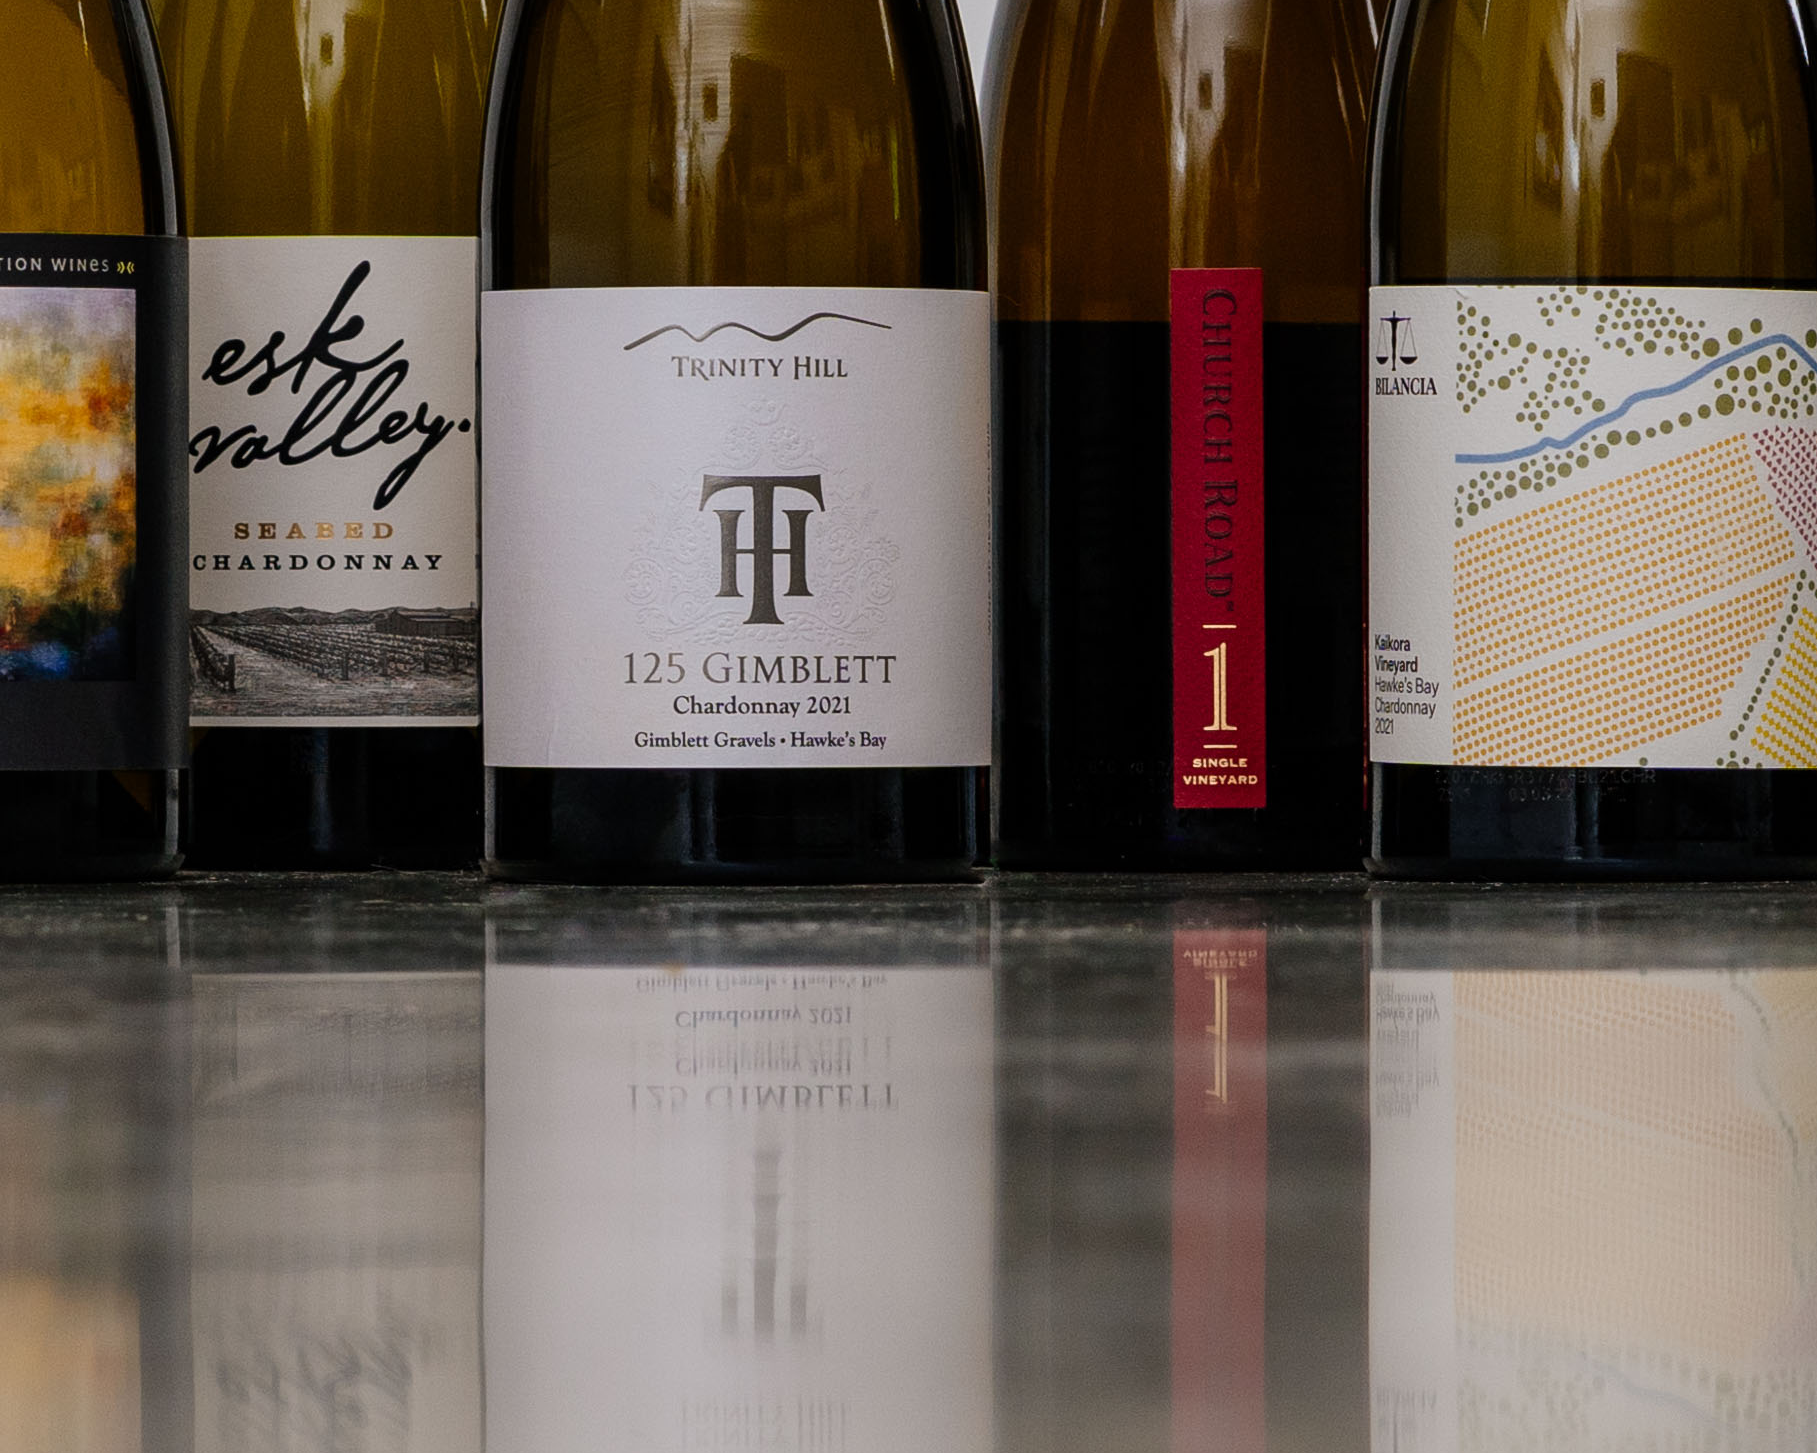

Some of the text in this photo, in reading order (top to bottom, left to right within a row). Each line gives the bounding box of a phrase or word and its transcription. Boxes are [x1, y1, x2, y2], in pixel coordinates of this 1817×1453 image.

[201, 260, 405, 396] esk
[671, 355, 848, 381] TRINITY HILL
[1202, 288, 1237, 464] CHURCH
[1375, 377, 1438, 396] BILANCIA
[233, 522, 394, 540] SEABED
[192, 554, 443, 571] CHARDONNAY
[1374, 635, 1410, 652] Kaikora
[624, 651, 897, 684] 125 GIMBLETT
[1374, 656, 1419, 675] Vineyard
[1202, 642, 1238, 731] 1
[1374, 677, 1439, 698] Hawke's Bay
[673, 695, 852, 718] Chardonnay 2021
[1374, 697, 1436, 719] Chardonnay
[634, 731, 887, 751] Gimblett Gravels Hawke's Bay
[1192, 758, 1248, 769] SINGLE
[1183, 774, 1258, 786] VINEYARD
